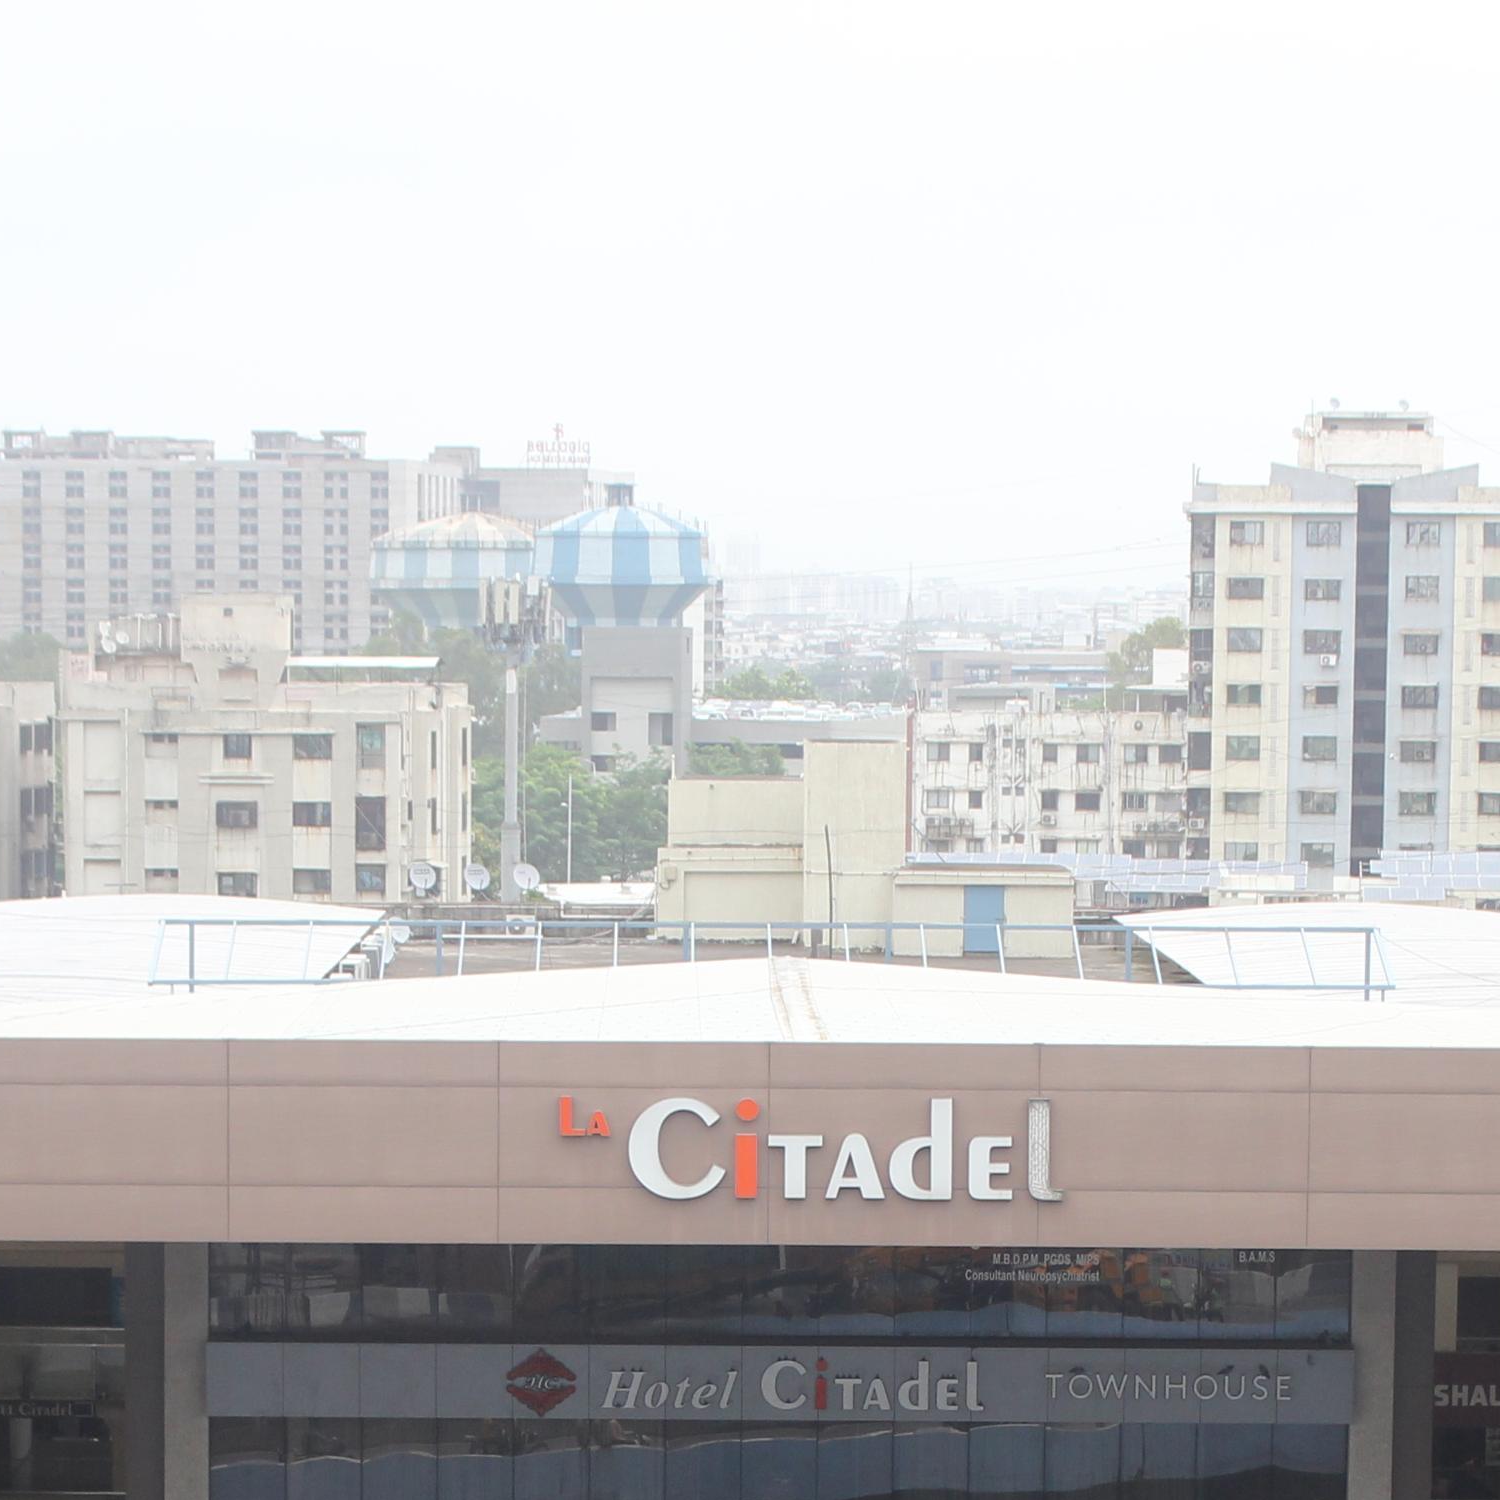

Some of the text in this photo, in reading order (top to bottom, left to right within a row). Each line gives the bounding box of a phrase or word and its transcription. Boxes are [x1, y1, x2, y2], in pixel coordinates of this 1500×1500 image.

[965, 1269, 1100, 1284] Consultant Neuropsychiatrist
[602, 1367, 738, 1409] Hotel
[1045, 1373, 1292, 1402] TOWNHOUSE
